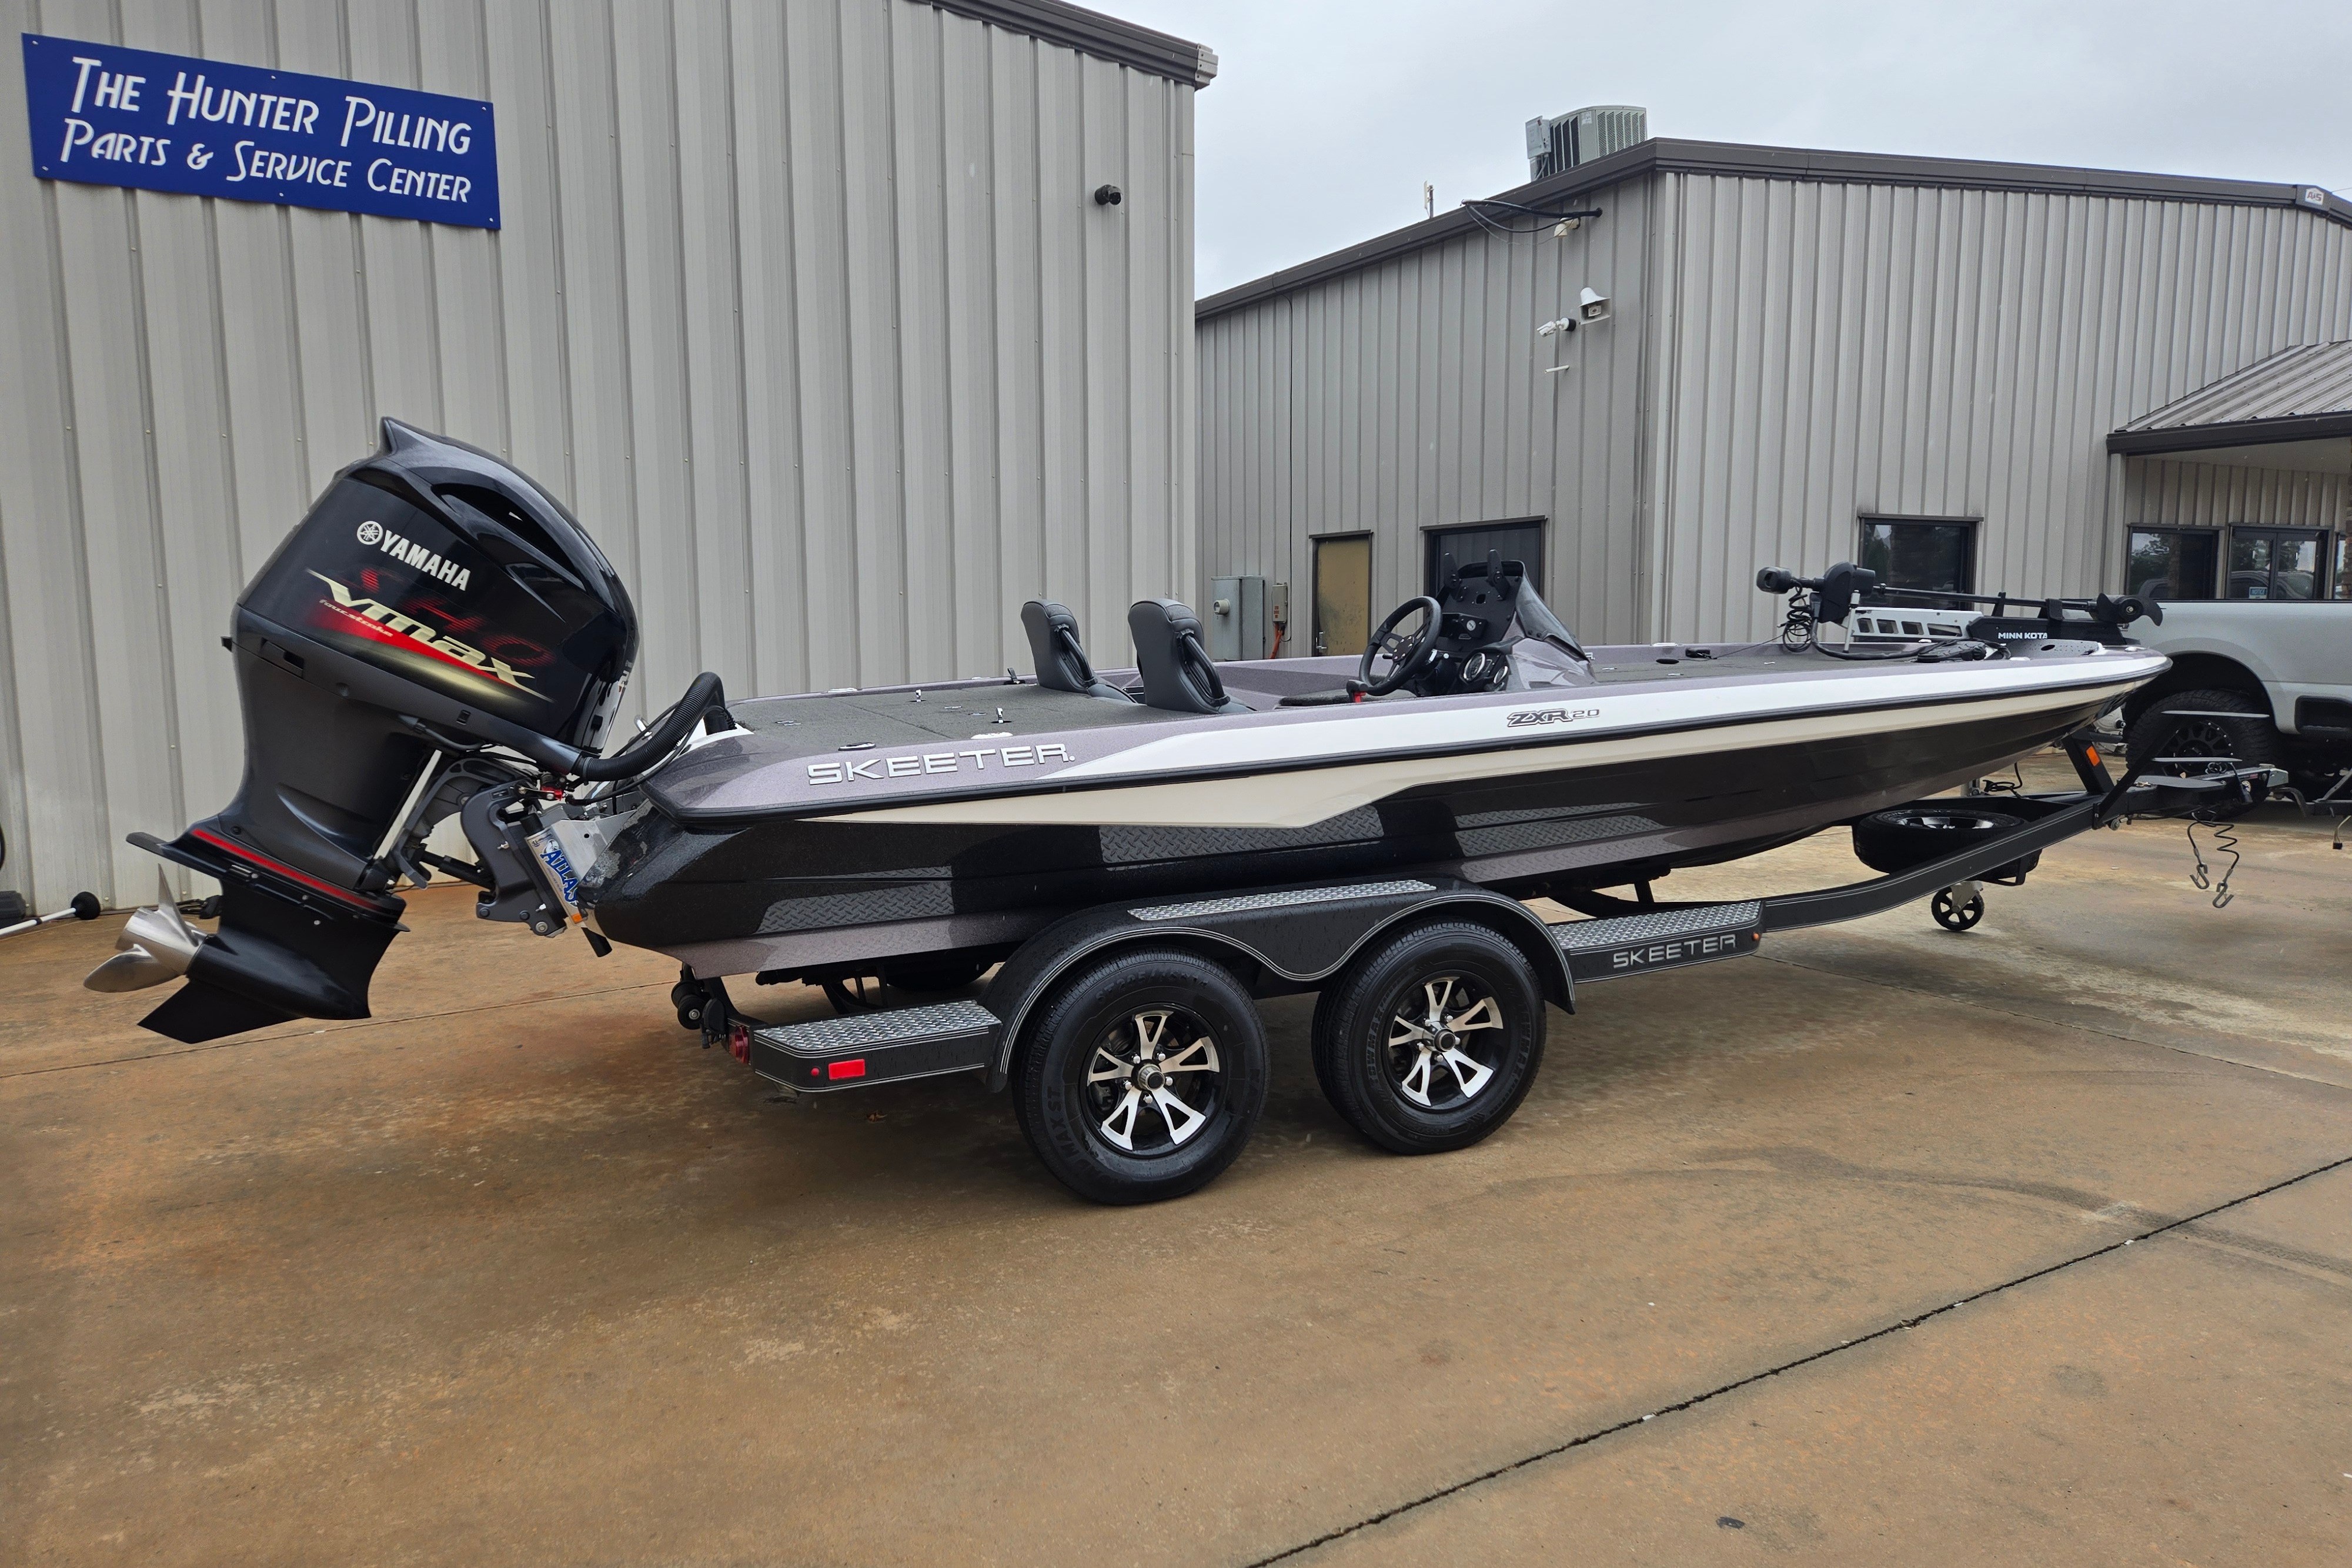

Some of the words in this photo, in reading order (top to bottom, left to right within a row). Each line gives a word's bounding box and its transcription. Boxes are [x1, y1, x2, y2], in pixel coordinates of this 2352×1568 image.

[186, 142, 214, 170] &
[380, 529, 471, 591] YAMAHA
[1507, 708, 1573, 727] ZXR
[1572, 708, 1600, 719] 20
[808, 743, 1075, 785] SKEETER
[539, 849, 579, 904] ATLAS
[1613, 934, 1736, 969] SKEETER
